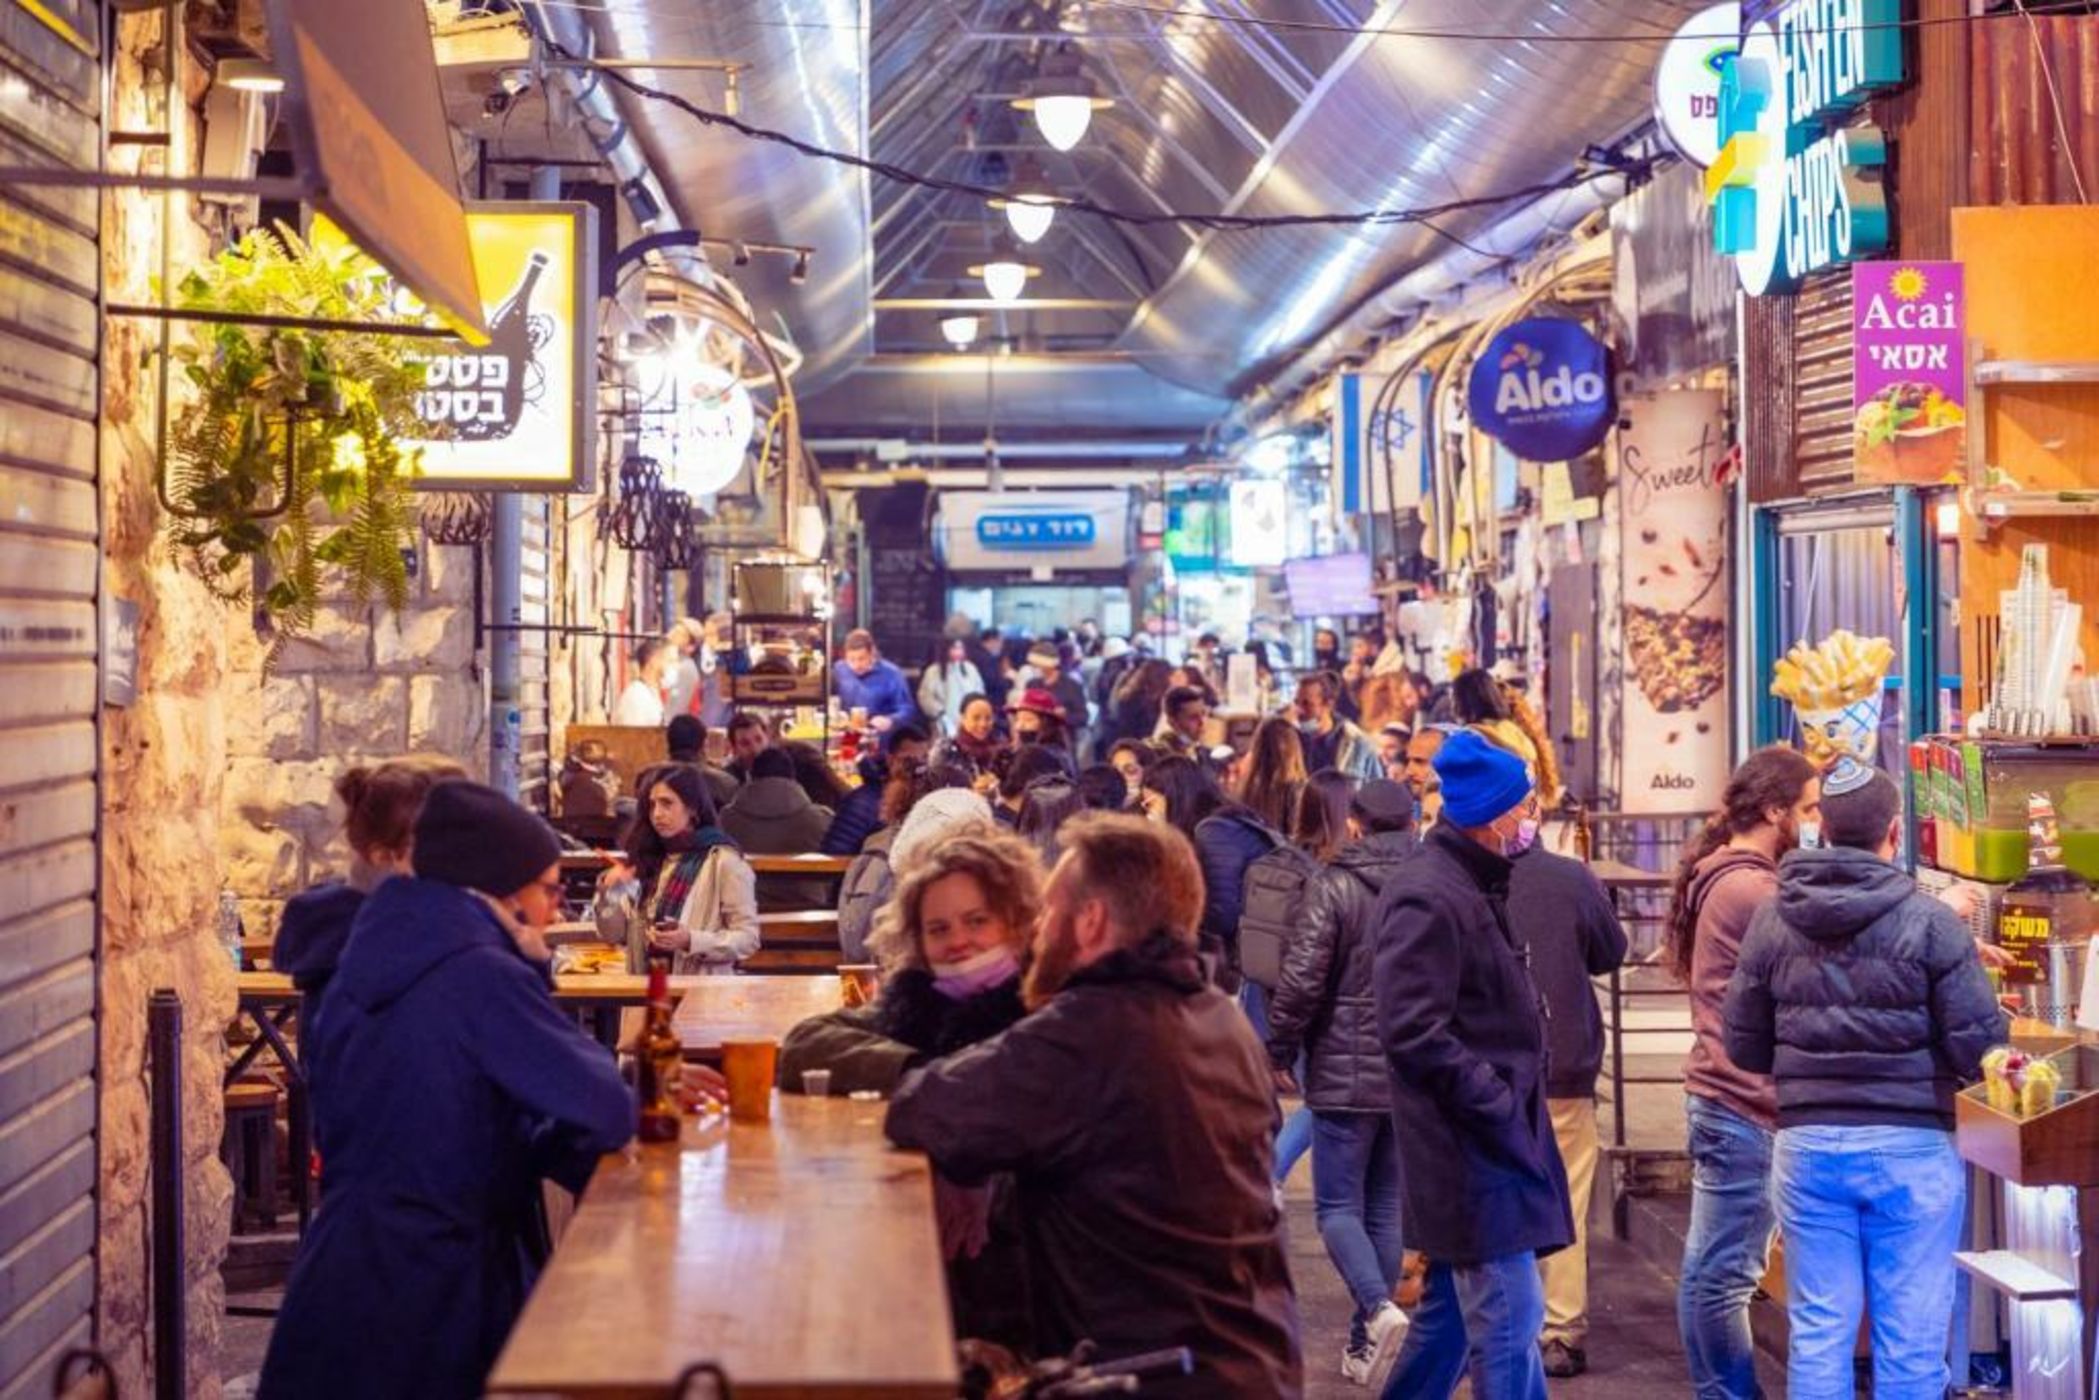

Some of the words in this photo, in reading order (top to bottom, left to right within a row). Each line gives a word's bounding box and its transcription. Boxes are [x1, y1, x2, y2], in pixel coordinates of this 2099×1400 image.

[1785, 128, 1851, 279] CHIPS
[1861, 291, 1957, 330] Acai
[1869, 344, 1948, 370] אסאי
[1495, 364, 1605, 413] Aldo
[1623, 423, 1715, 516] Sweet
[1650, 772, 1695, 790] Aldo
